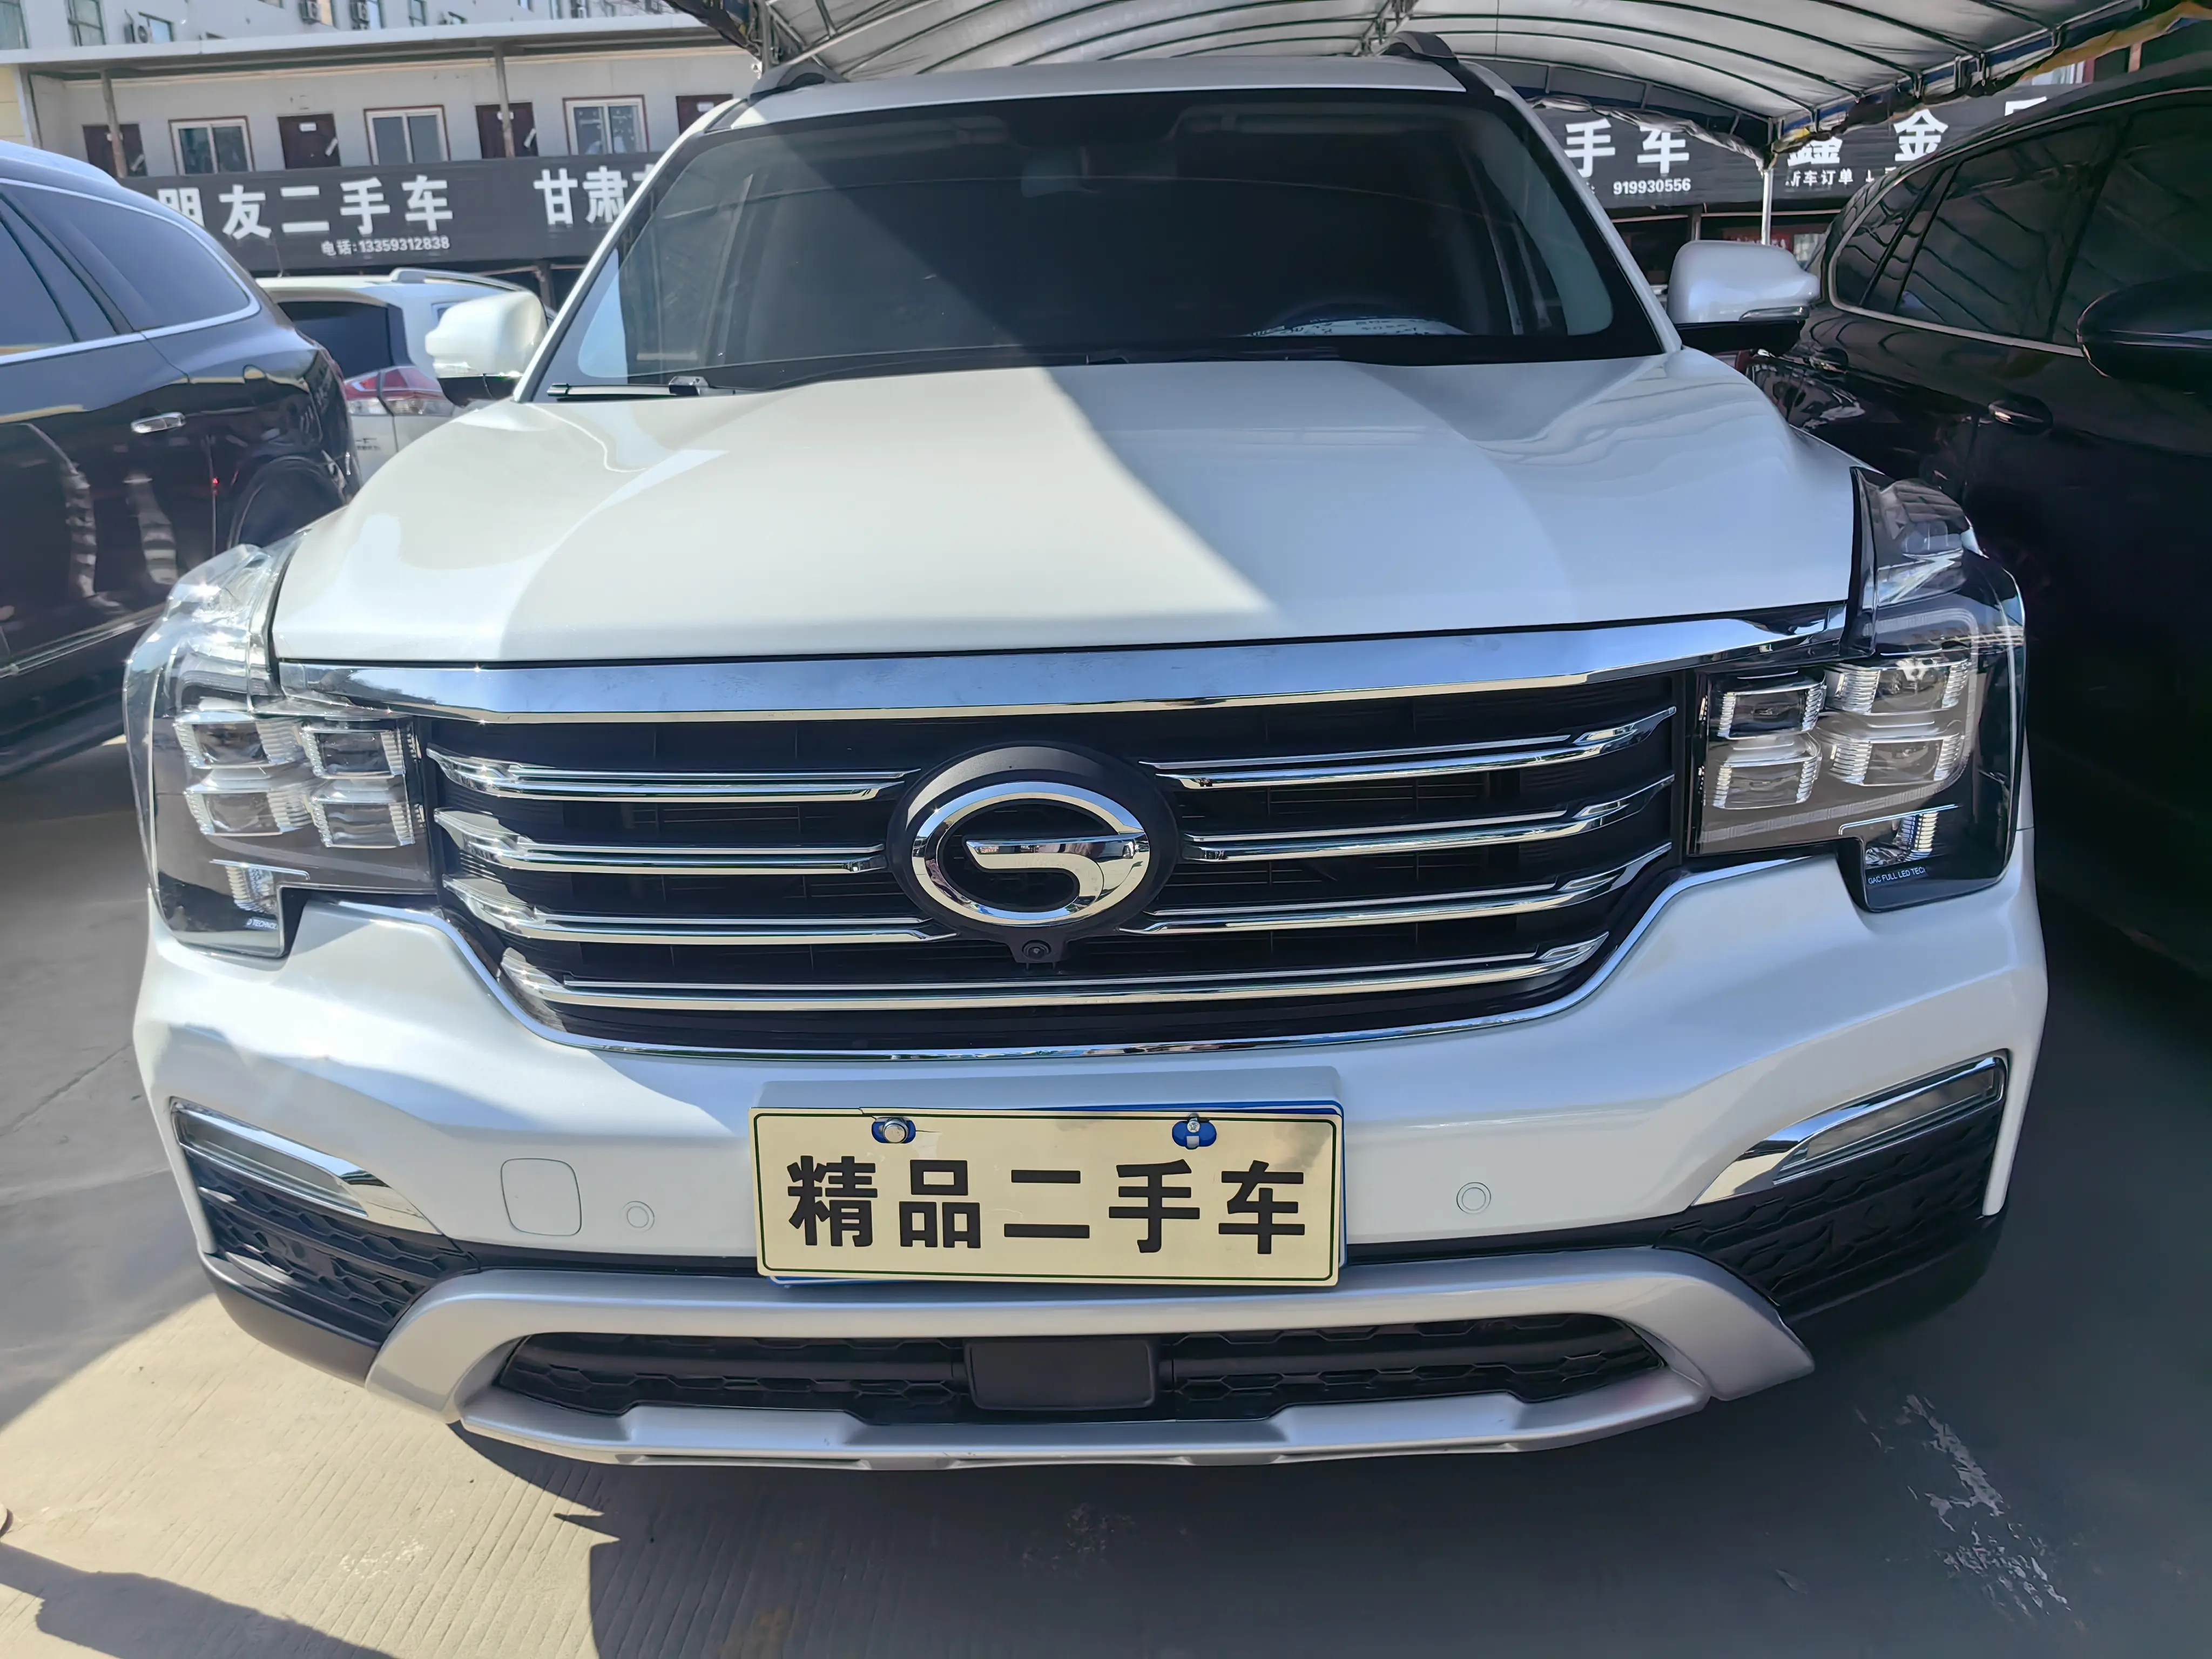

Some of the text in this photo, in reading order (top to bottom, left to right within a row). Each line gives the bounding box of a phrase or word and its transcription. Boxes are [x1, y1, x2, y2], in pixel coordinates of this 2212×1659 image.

[1564, 118, 1690, 178] 手车
[1613, 178, 1691, 195] 919930556
[1868, 876, 1881, 884] GAC
[1881, 873, 1898, 881] FULL
[1898, 869, 1910, 878] LED
[787, 1155, 1305, 1255] 精品二手车
